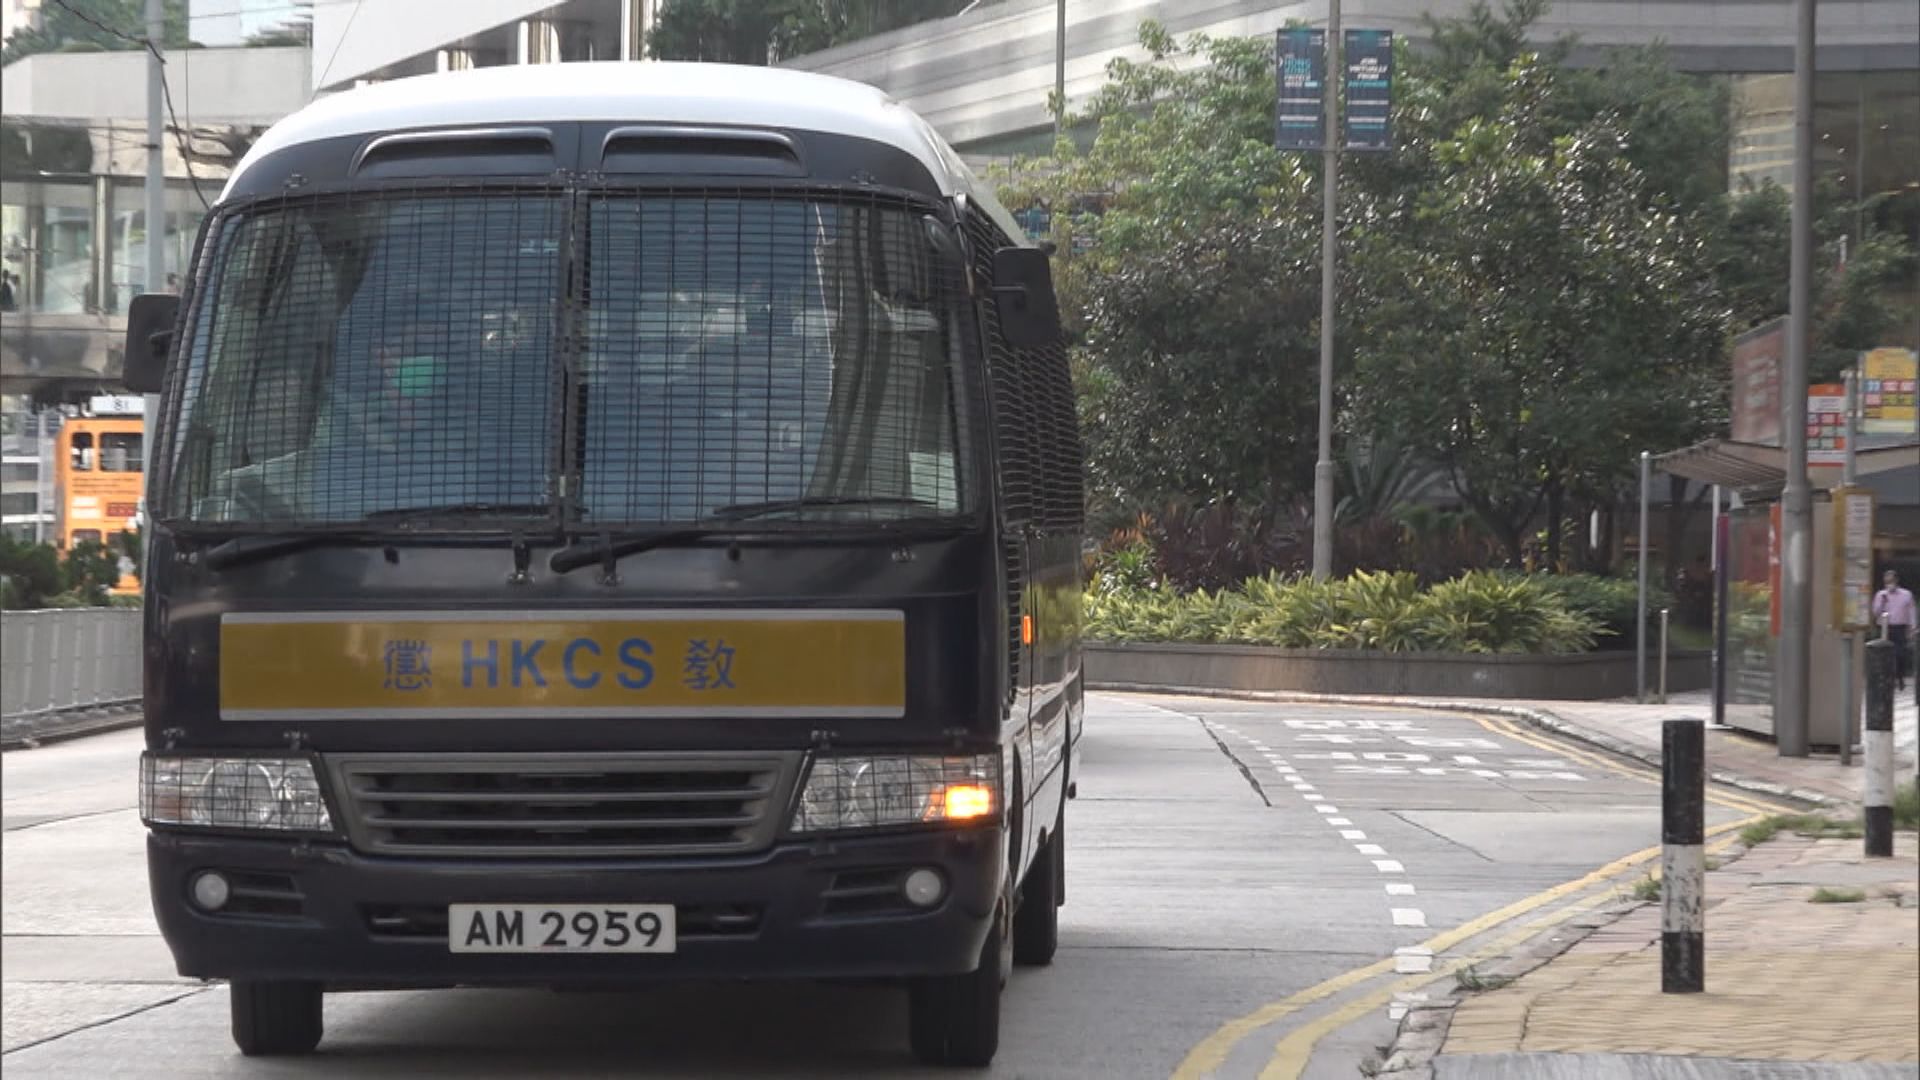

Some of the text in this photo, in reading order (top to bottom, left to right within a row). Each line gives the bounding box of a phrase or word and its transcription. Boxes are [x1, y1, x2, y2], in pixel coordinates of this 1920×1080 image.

[462, 638, 655, 689] HKCS
[465, 909, 662, 947] AM 2959
